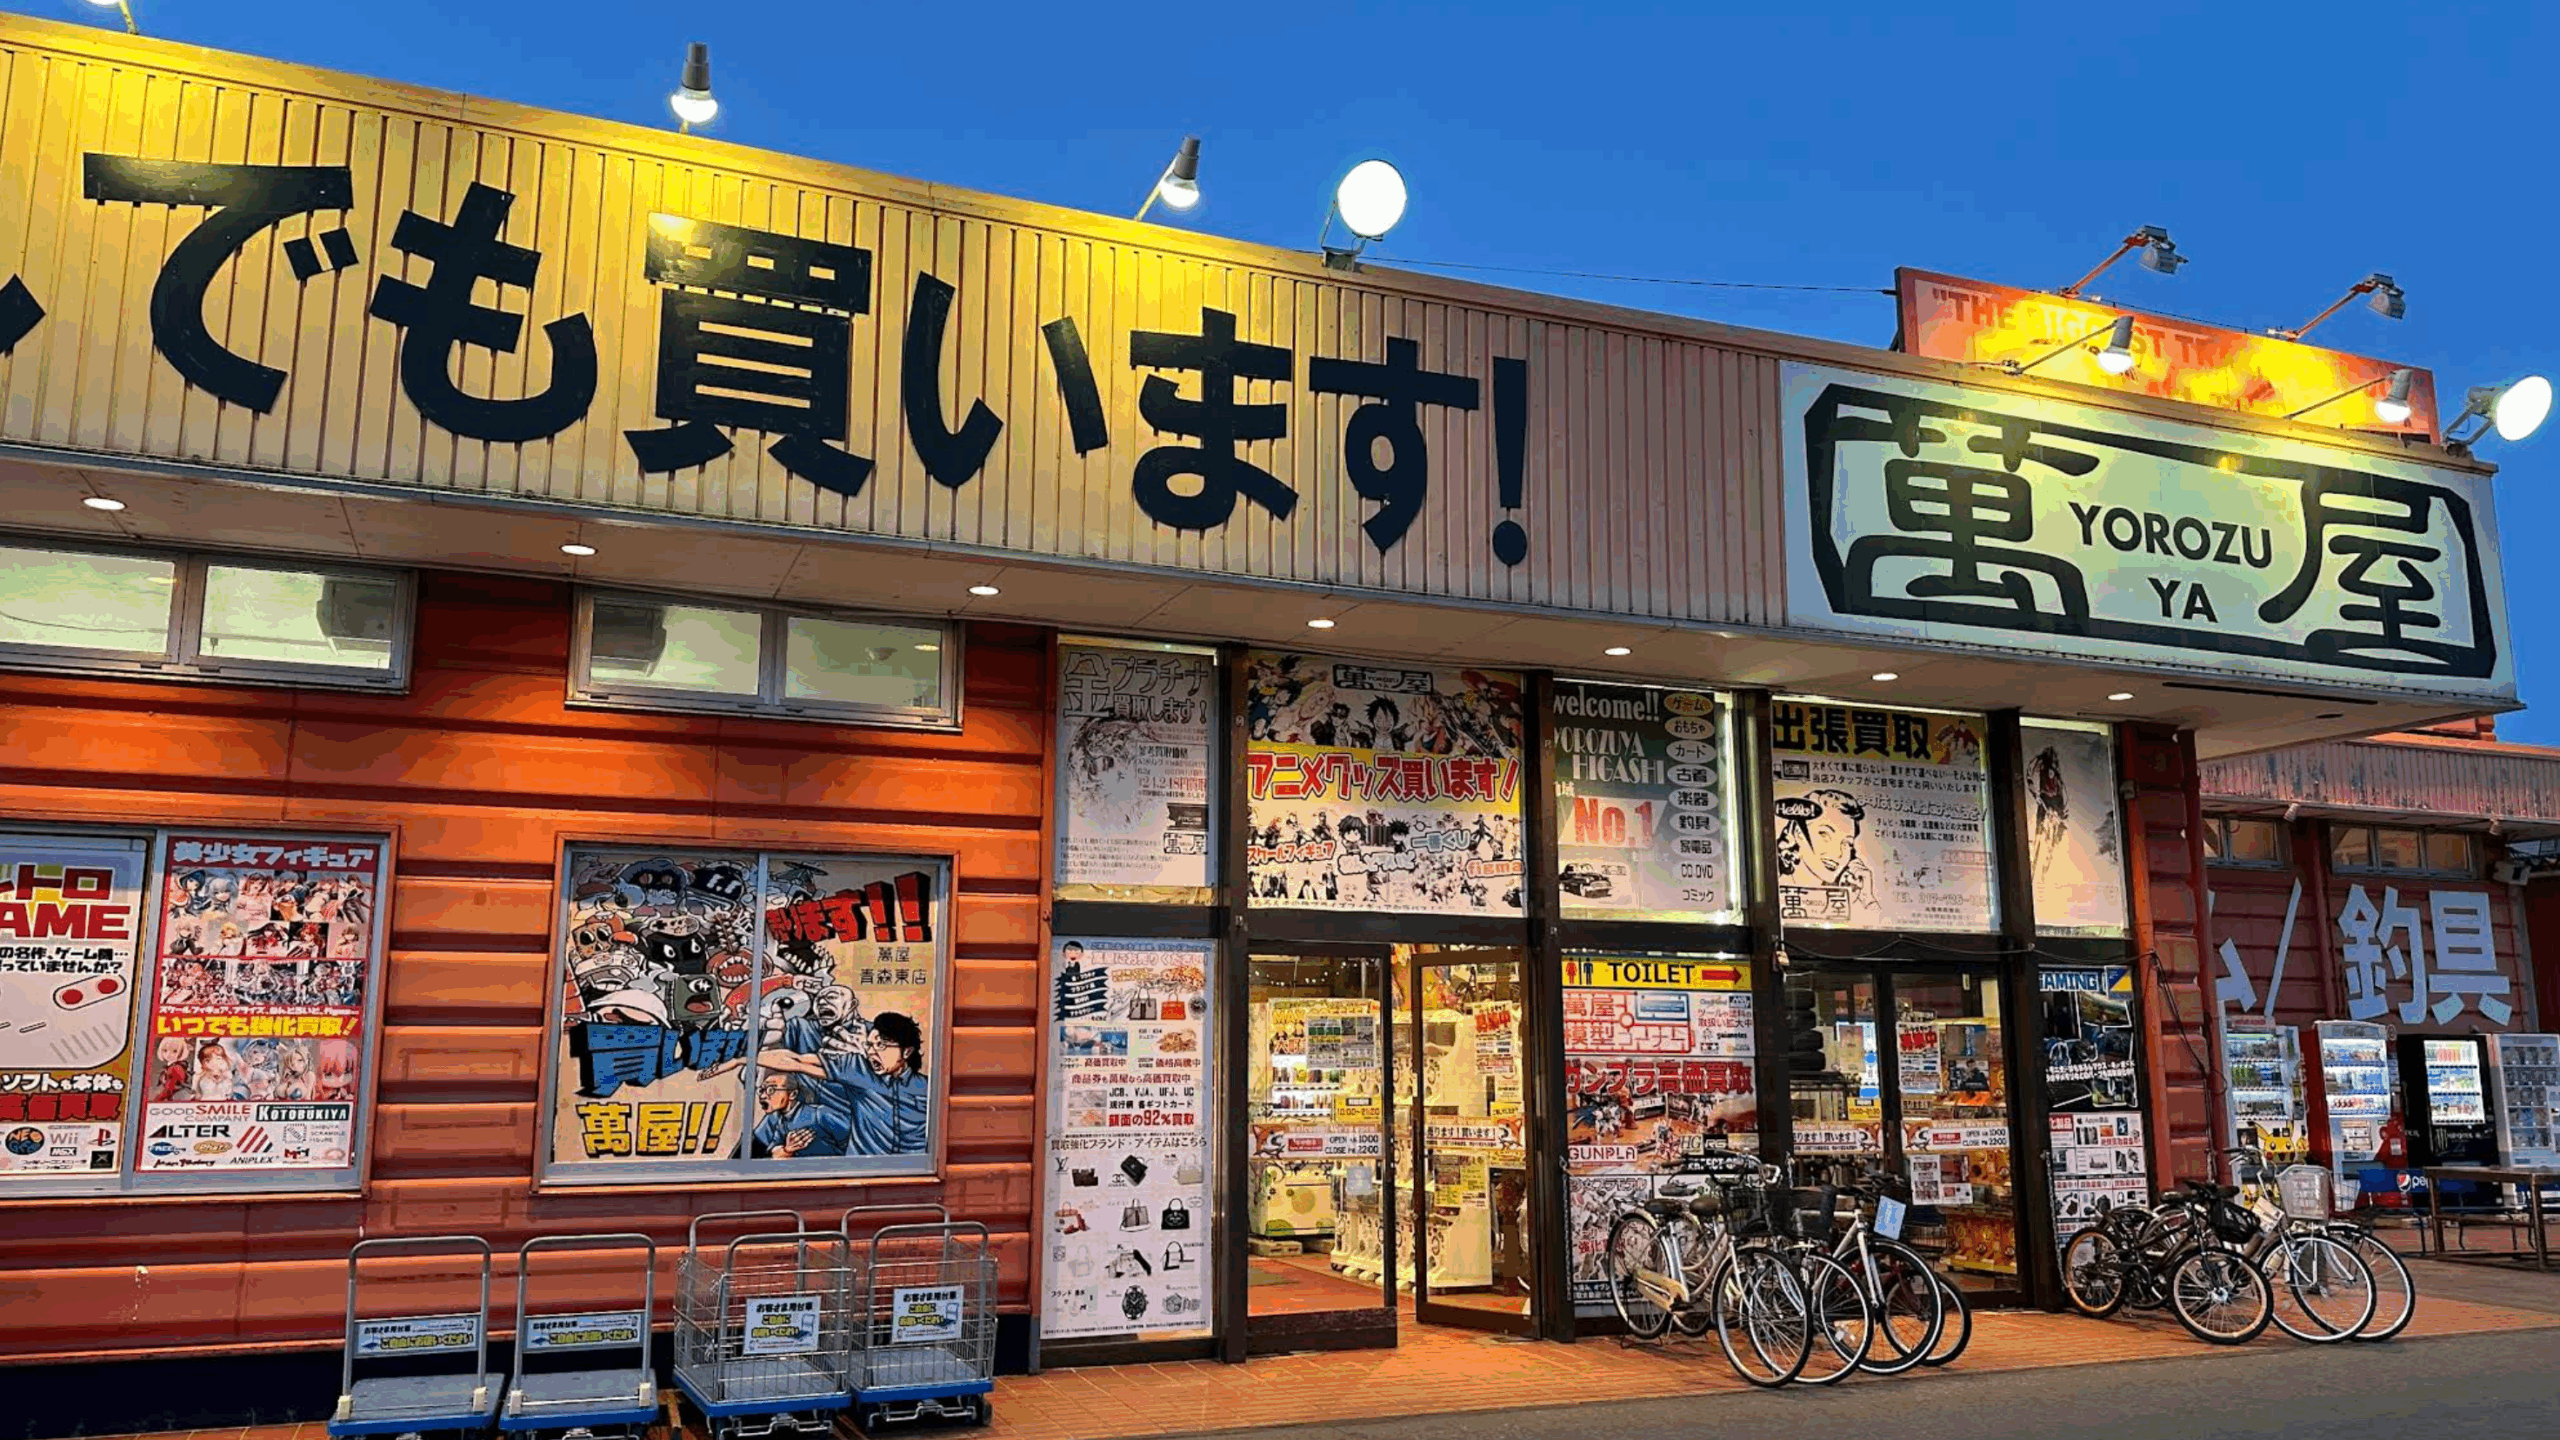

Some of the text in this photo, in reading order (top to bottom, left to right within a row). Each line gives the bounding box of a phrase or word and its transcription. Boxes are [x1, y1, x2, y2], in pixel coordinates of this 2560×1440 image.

[0, 152, 1528, 566] でも買います!
[2068, 504, 2272, 569] YOROZU
[2148, 576, 2220, 625] YA
[1063, 652, 1209, 718] 金 プラチナ
[1112, 692, 1208, 724] 買取します!
[1673, 697, 1706, 711] ゲーム
[1674, 720, 1705, 733] おもちゃ
[1772, 703, 1931, 760] 出張買取
[1675, 744, 1706, 757] カード
[1248, 752, 1521, 801] アニメグッズ買います!
[1572, 753, 1665, 785] HIGASHI
[1676, 768, 1708, 783] 古着
[1678, 791, 1709, 807] 楽器
[1776, 803, 1816, 817] Hello!
[1573, 797, 1653, 847] No.1
[1679, 815, 1710, 830] 釣具
[1248, 840, 1336, 865] スケールフィギュア
[1680, 840, 1712, 854] 家電品
[173, 842, 375, 869] 美少女フィギュア
[1467, 859, 1523, 877] figma
[0, 863, 115, 900] トロ
[1682, 888, 1714, 903] コミック
[877, 946, 910, 963] 萬屋
[2337, 884, 2513, 1026] 釣具
[0, 961, 122, 974] っていませんか?
[1606, 962, 1695, 983] TOILET
[860, 968, 927, 986] 青森東店
[2038, 970, 2097, 991] AMING
[1084, 1057, 1126, 1068] 高価買取中
[196, 1105, 251, 1115] SMILE
[258, 1105, 347, 1121] KOTOBUKIYA
[1108, 1110, 1195, 1127] 額面の92%買取
[149, 1124, 231, 1138] ALTER
[575, 1101, 733, 1159] 萬屋!!
[49, 1132, 79, 1145] Wii
[1051, 1137, 1207, 1150] 買取強化ブランド・アイテムはこちら
[1329, 1136, 1347, 1144] OPEN
[1681, 1135, 1701, 1150] HG
[1705, 1138, 1728, 1148] RG
[50, 1147, 77, 1156] MSX
[1324, 1146, 1346, 1154] CLOSE
[1568, 1146, 1636, 1160] GUNPLA
[230, 1156, 274, 1164] ANIPLEX
